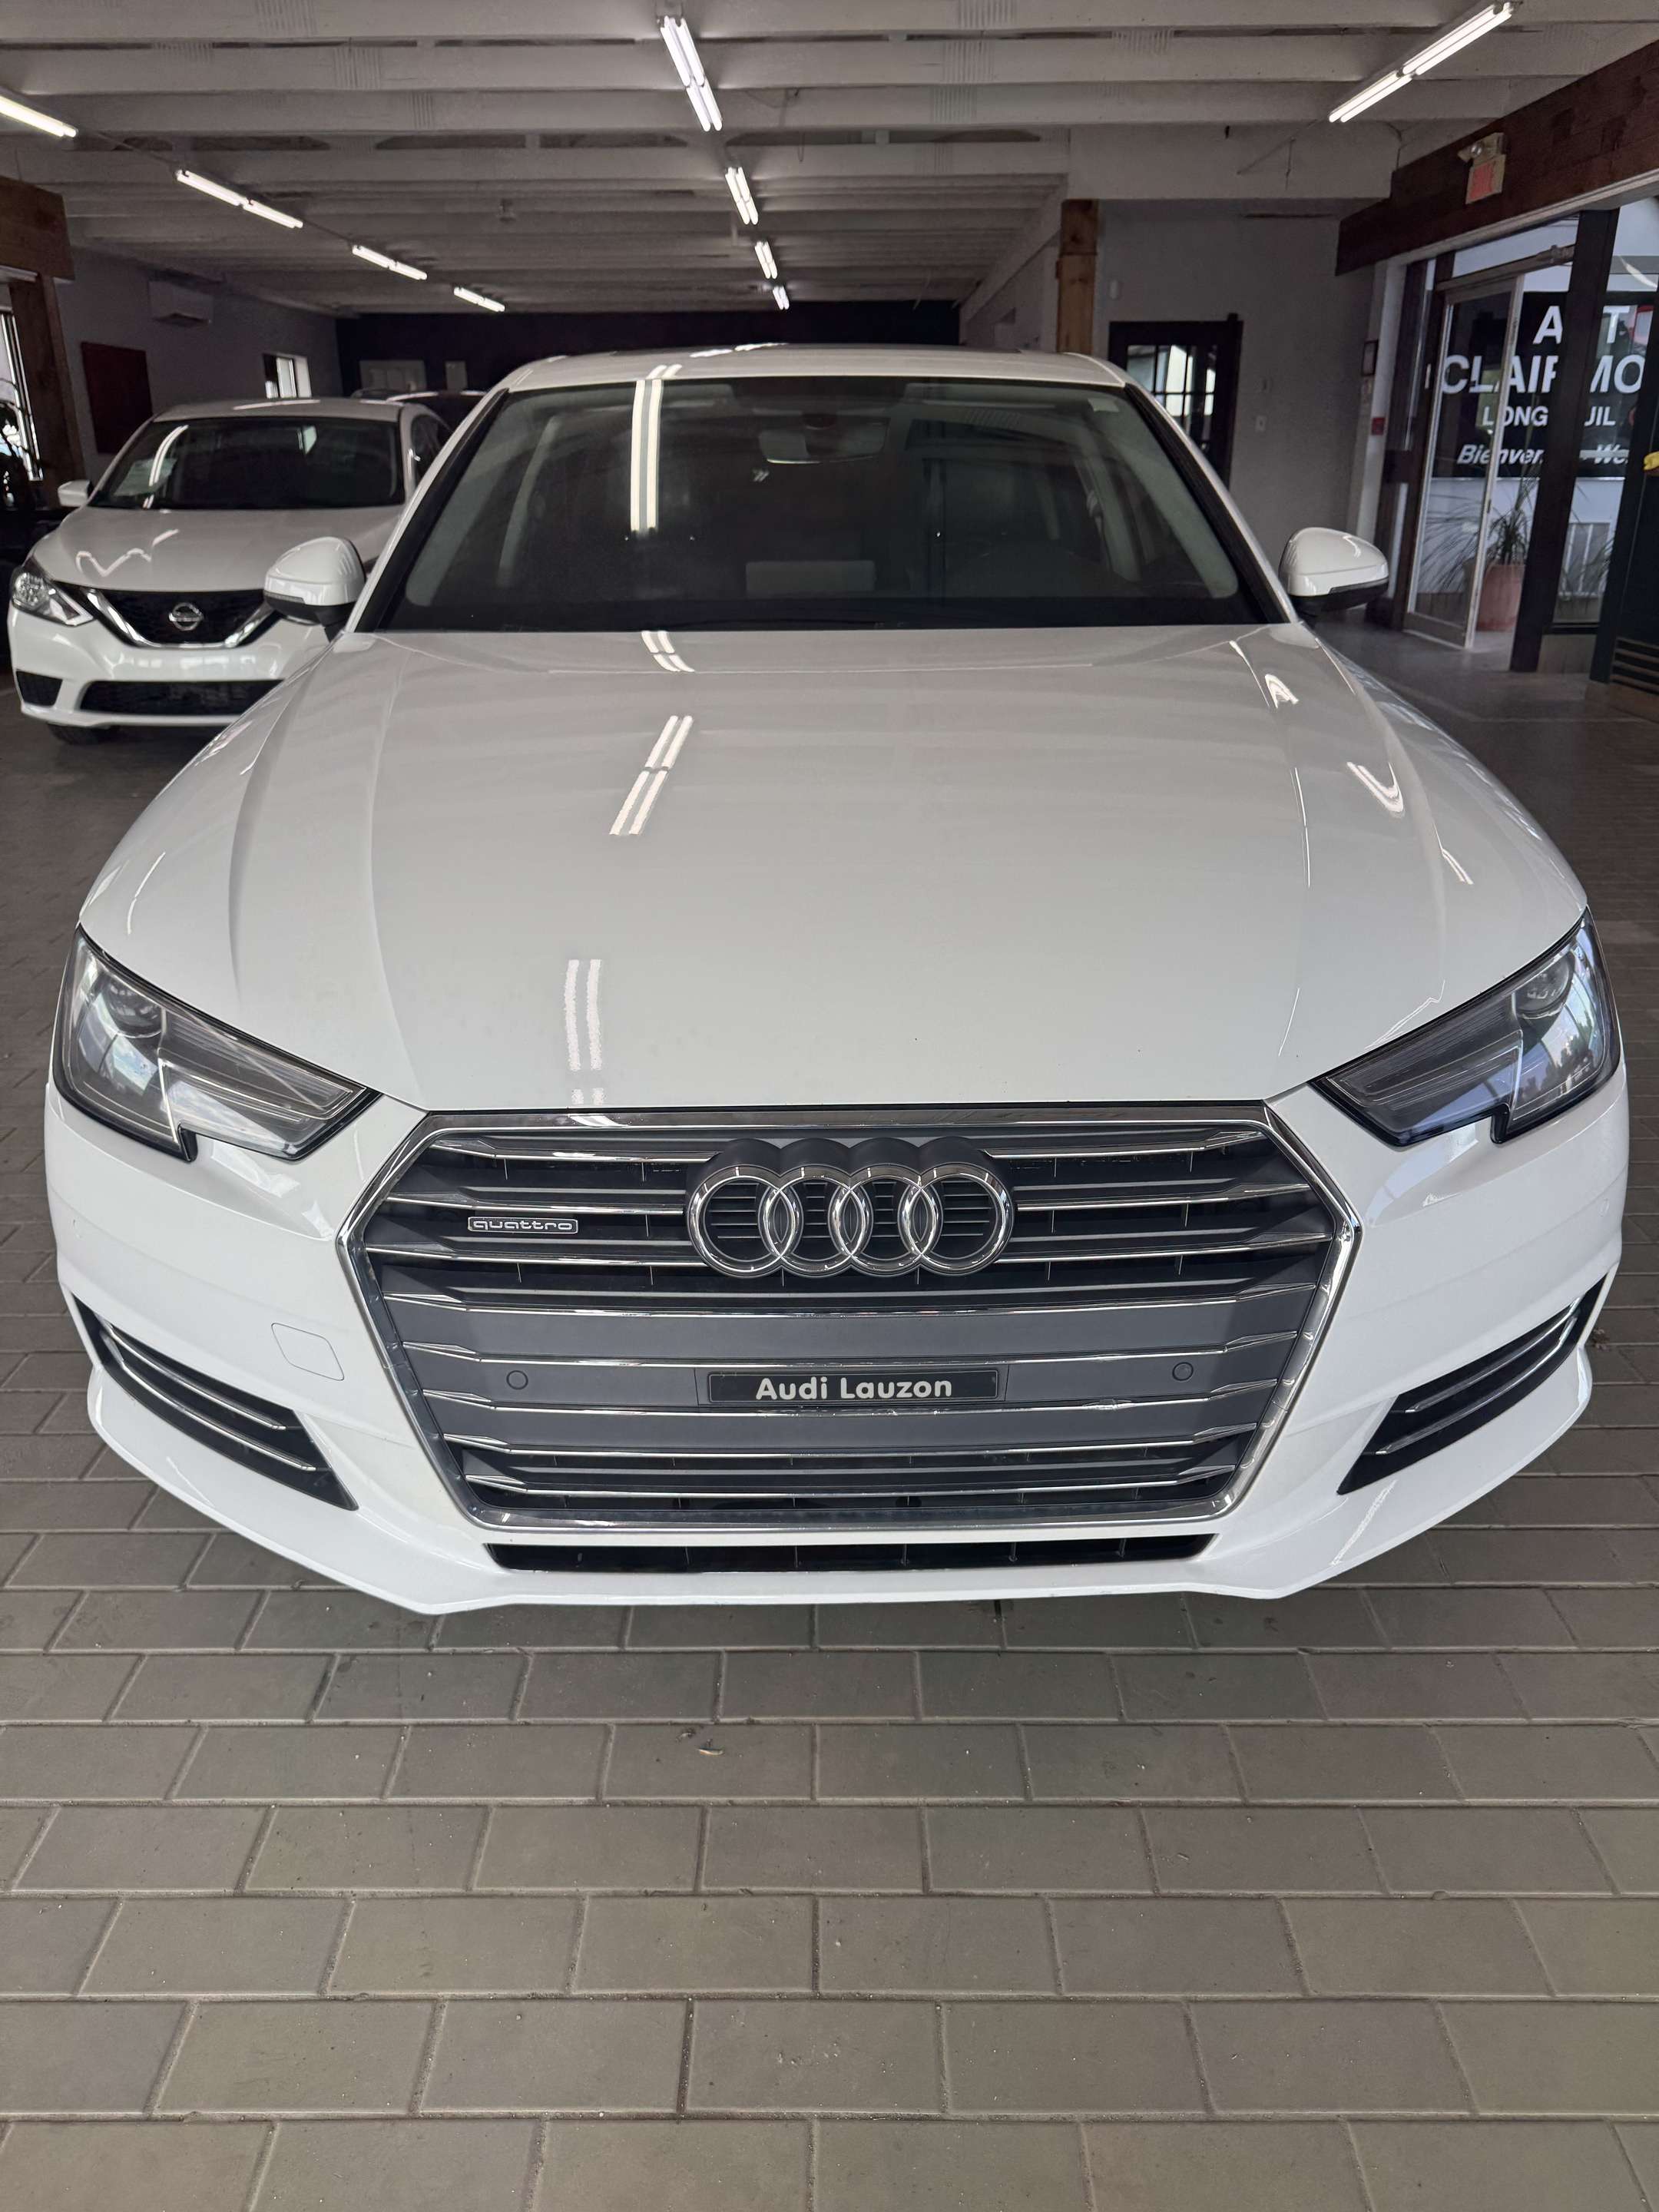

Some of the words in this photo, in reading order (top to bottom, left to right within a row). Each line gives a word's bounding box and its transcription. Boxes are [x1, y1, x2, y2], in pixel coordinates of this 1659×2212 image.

[1532, 305, 1631, 344] AT
[472, 1220, 573, 1230] quattro
[755, 1376, 828, 1401] Audi
[840, 1376, 953, 1400] Lauzon
